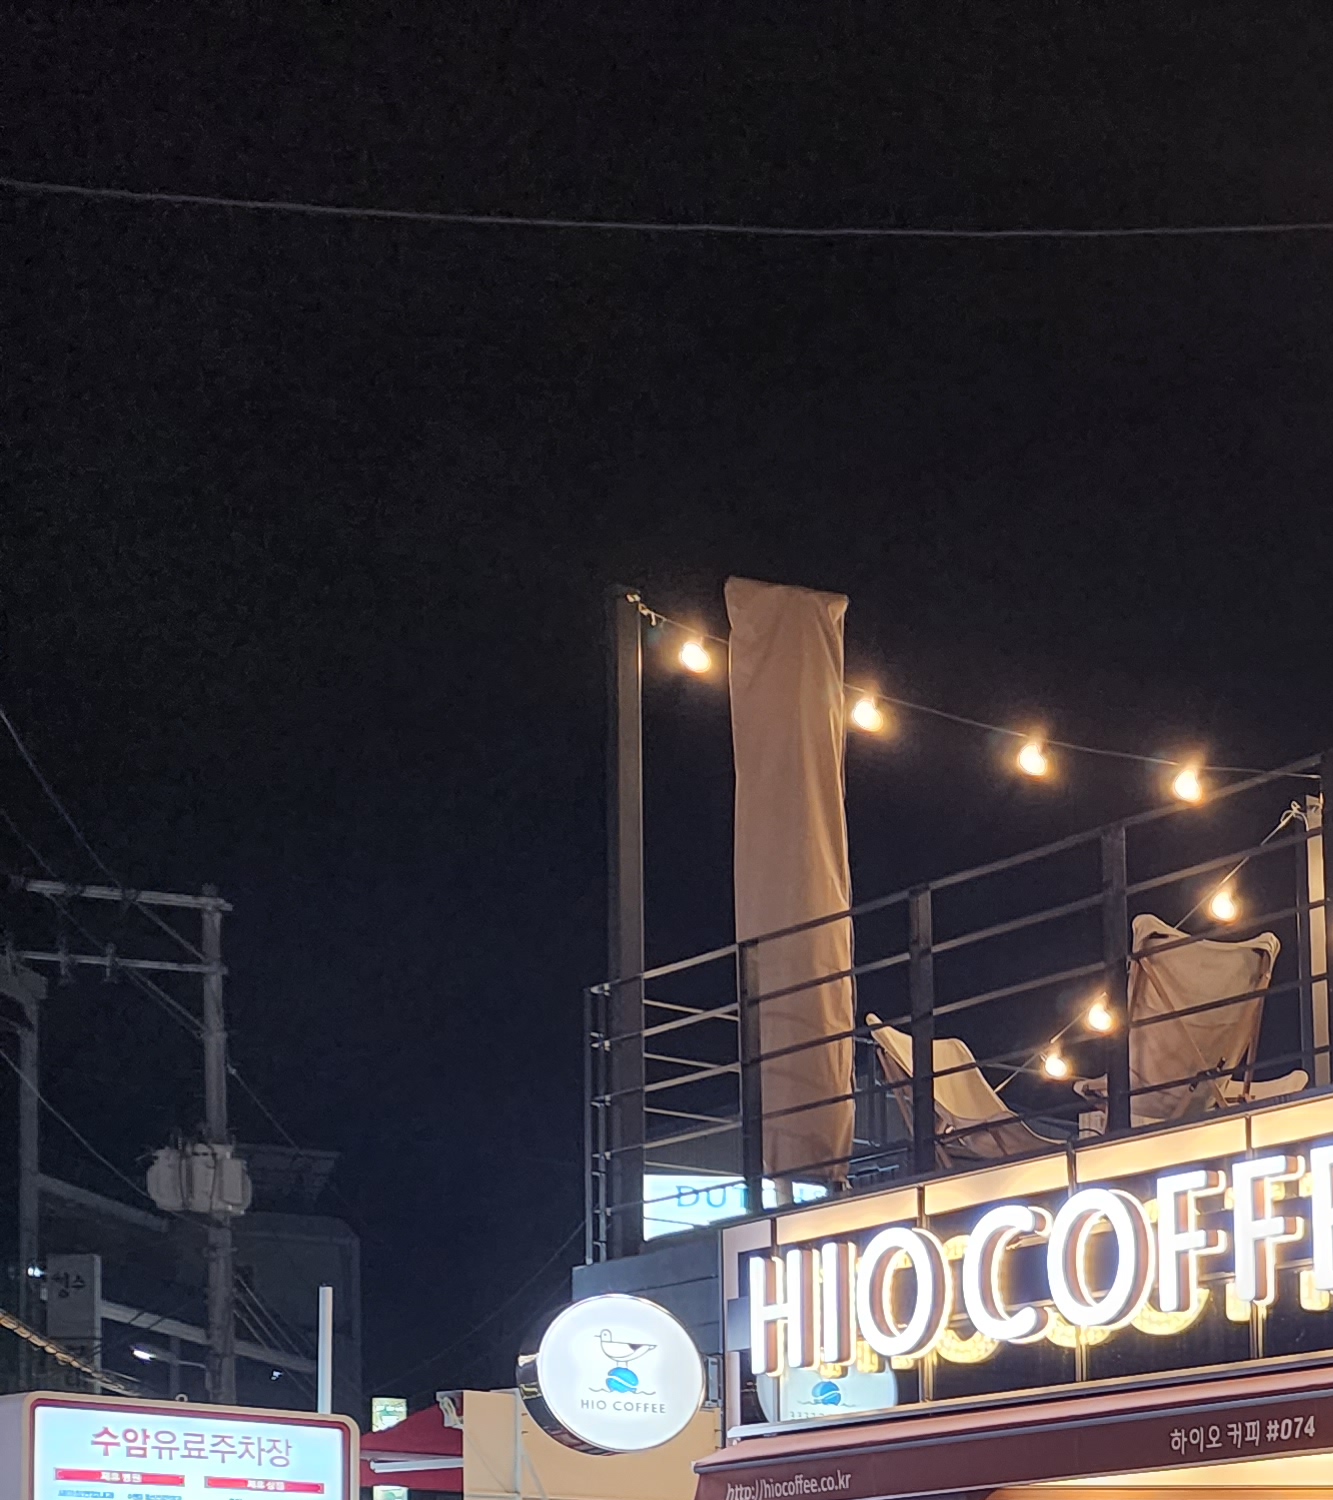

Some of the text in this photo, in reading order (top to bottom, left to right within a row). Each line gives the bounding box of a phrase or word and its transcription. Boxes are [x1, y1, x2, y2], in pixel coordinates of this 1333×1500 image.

[748, 1226, 951, 1375] HIO
[580, 1398, 666, 1414] HIO COFFEE
[90, 1426, 293, 1468] 수암유료주차장
[1170, 1415, 1316, 1455] 하이오 커피 #074
